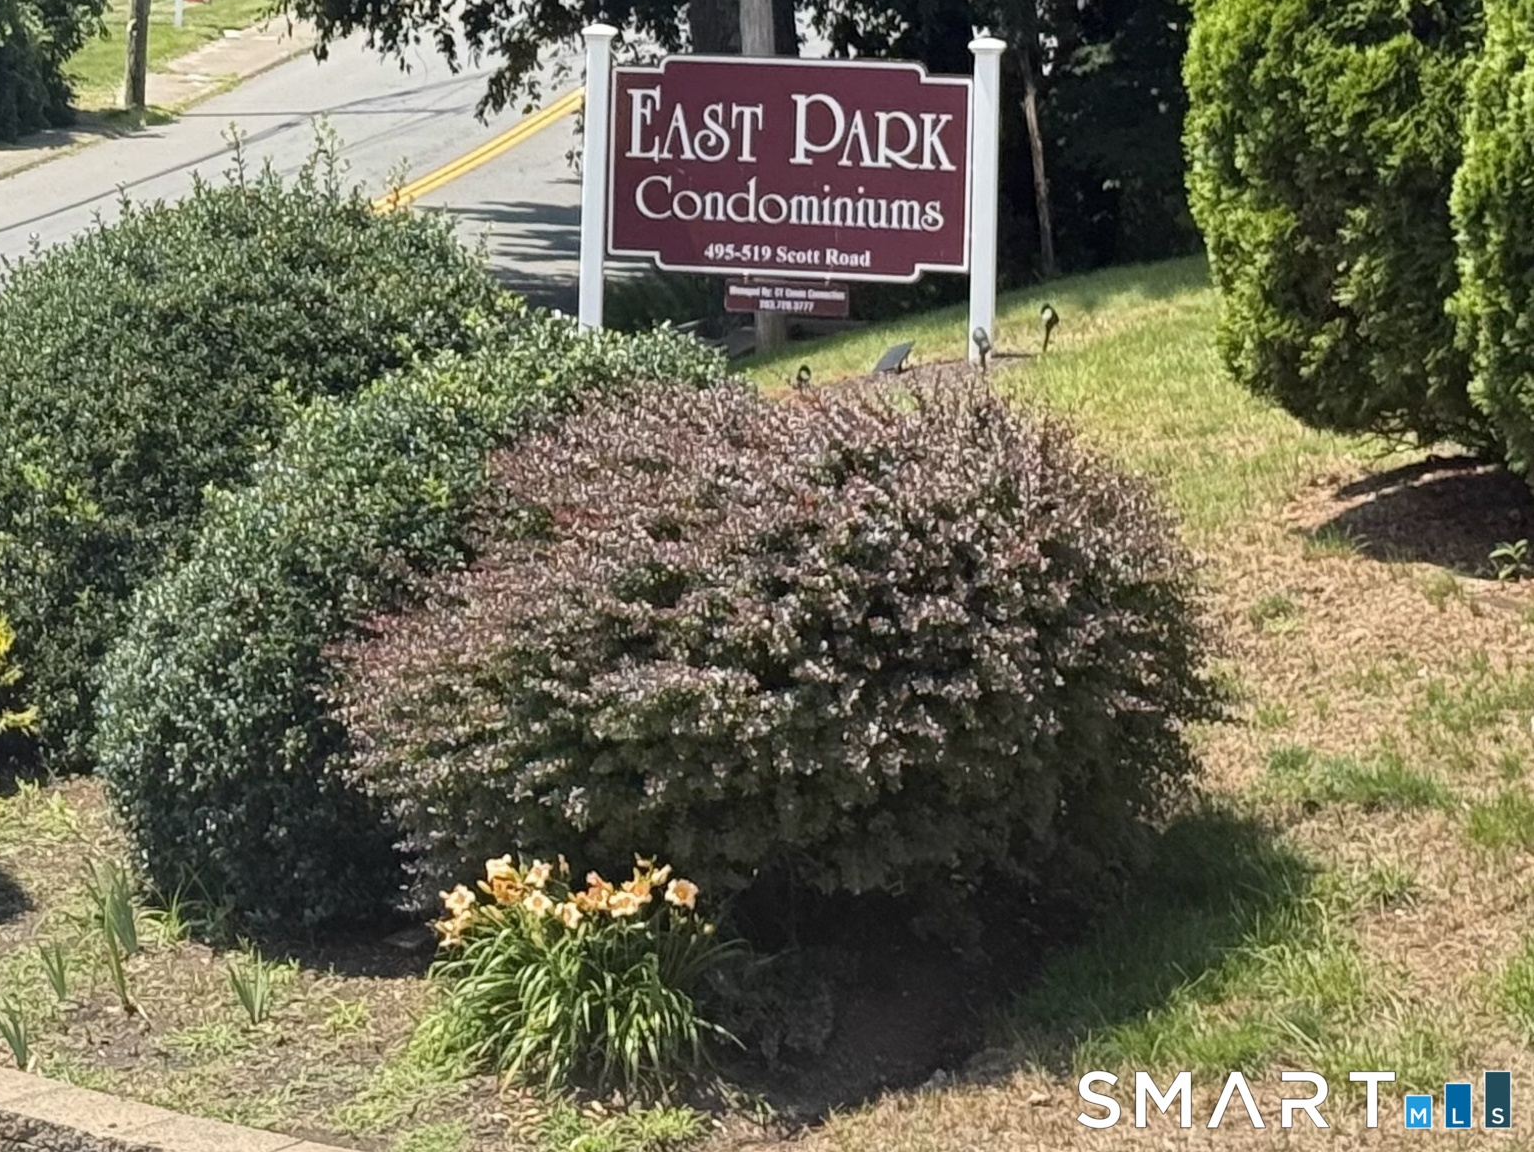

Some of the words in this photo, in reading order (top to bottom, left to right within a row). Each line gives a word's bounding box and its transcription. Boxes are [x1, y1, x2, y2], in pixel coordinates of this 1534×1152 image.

[625, 85, 763, 164] EAST
[789, 93, 957, 172] PARK
[635, 176, 945, 233] Condominiums
[704, 243, 772, 263] 495-519
[775, 246, 820, 265] Scott
[825, 248, 872, 268] Road
